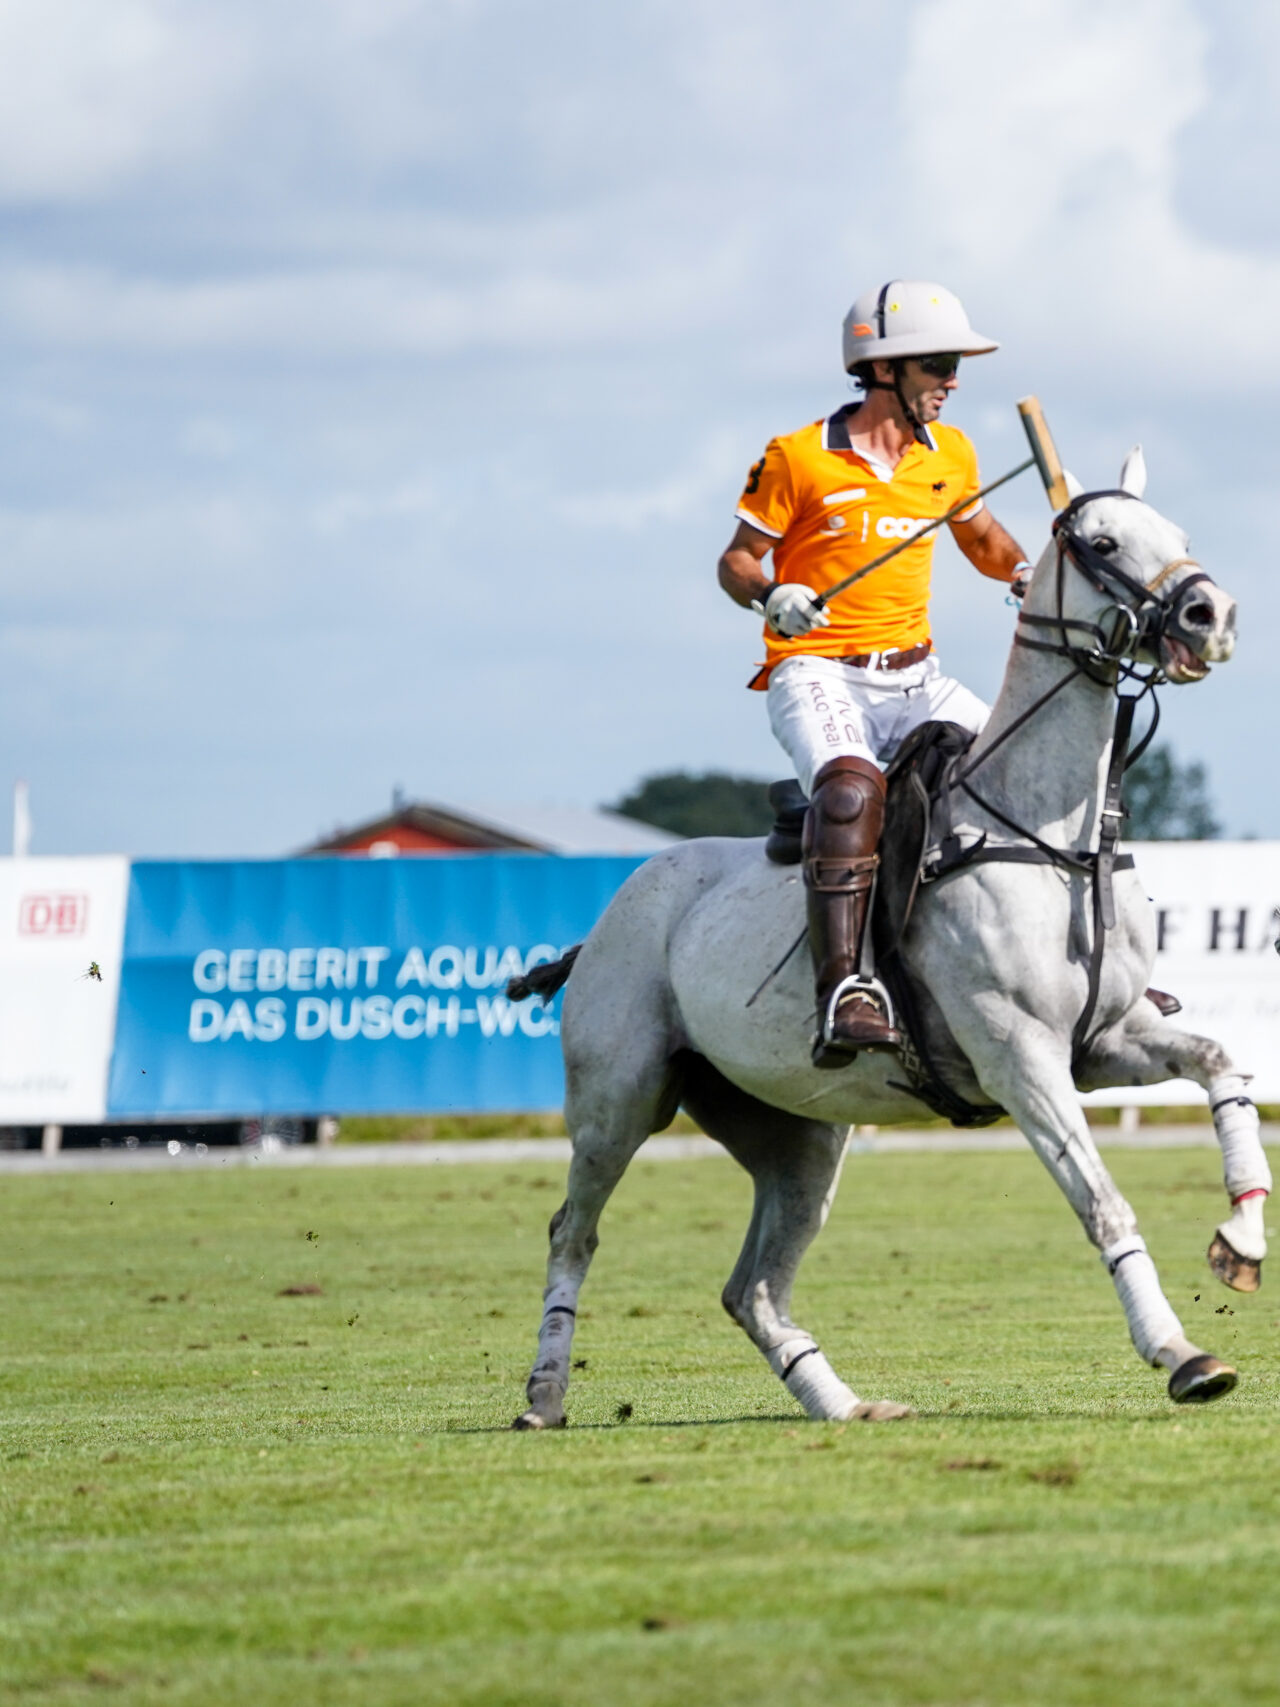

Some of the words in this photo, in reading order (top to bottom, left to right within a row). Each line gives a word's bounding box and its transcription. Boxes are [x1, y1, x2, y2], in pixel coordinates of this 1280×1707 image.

[26, 893, 80, 936] DB
[193, 946, 391, 993] GEBERIT
[189, 997, 286, 1042] DAS
